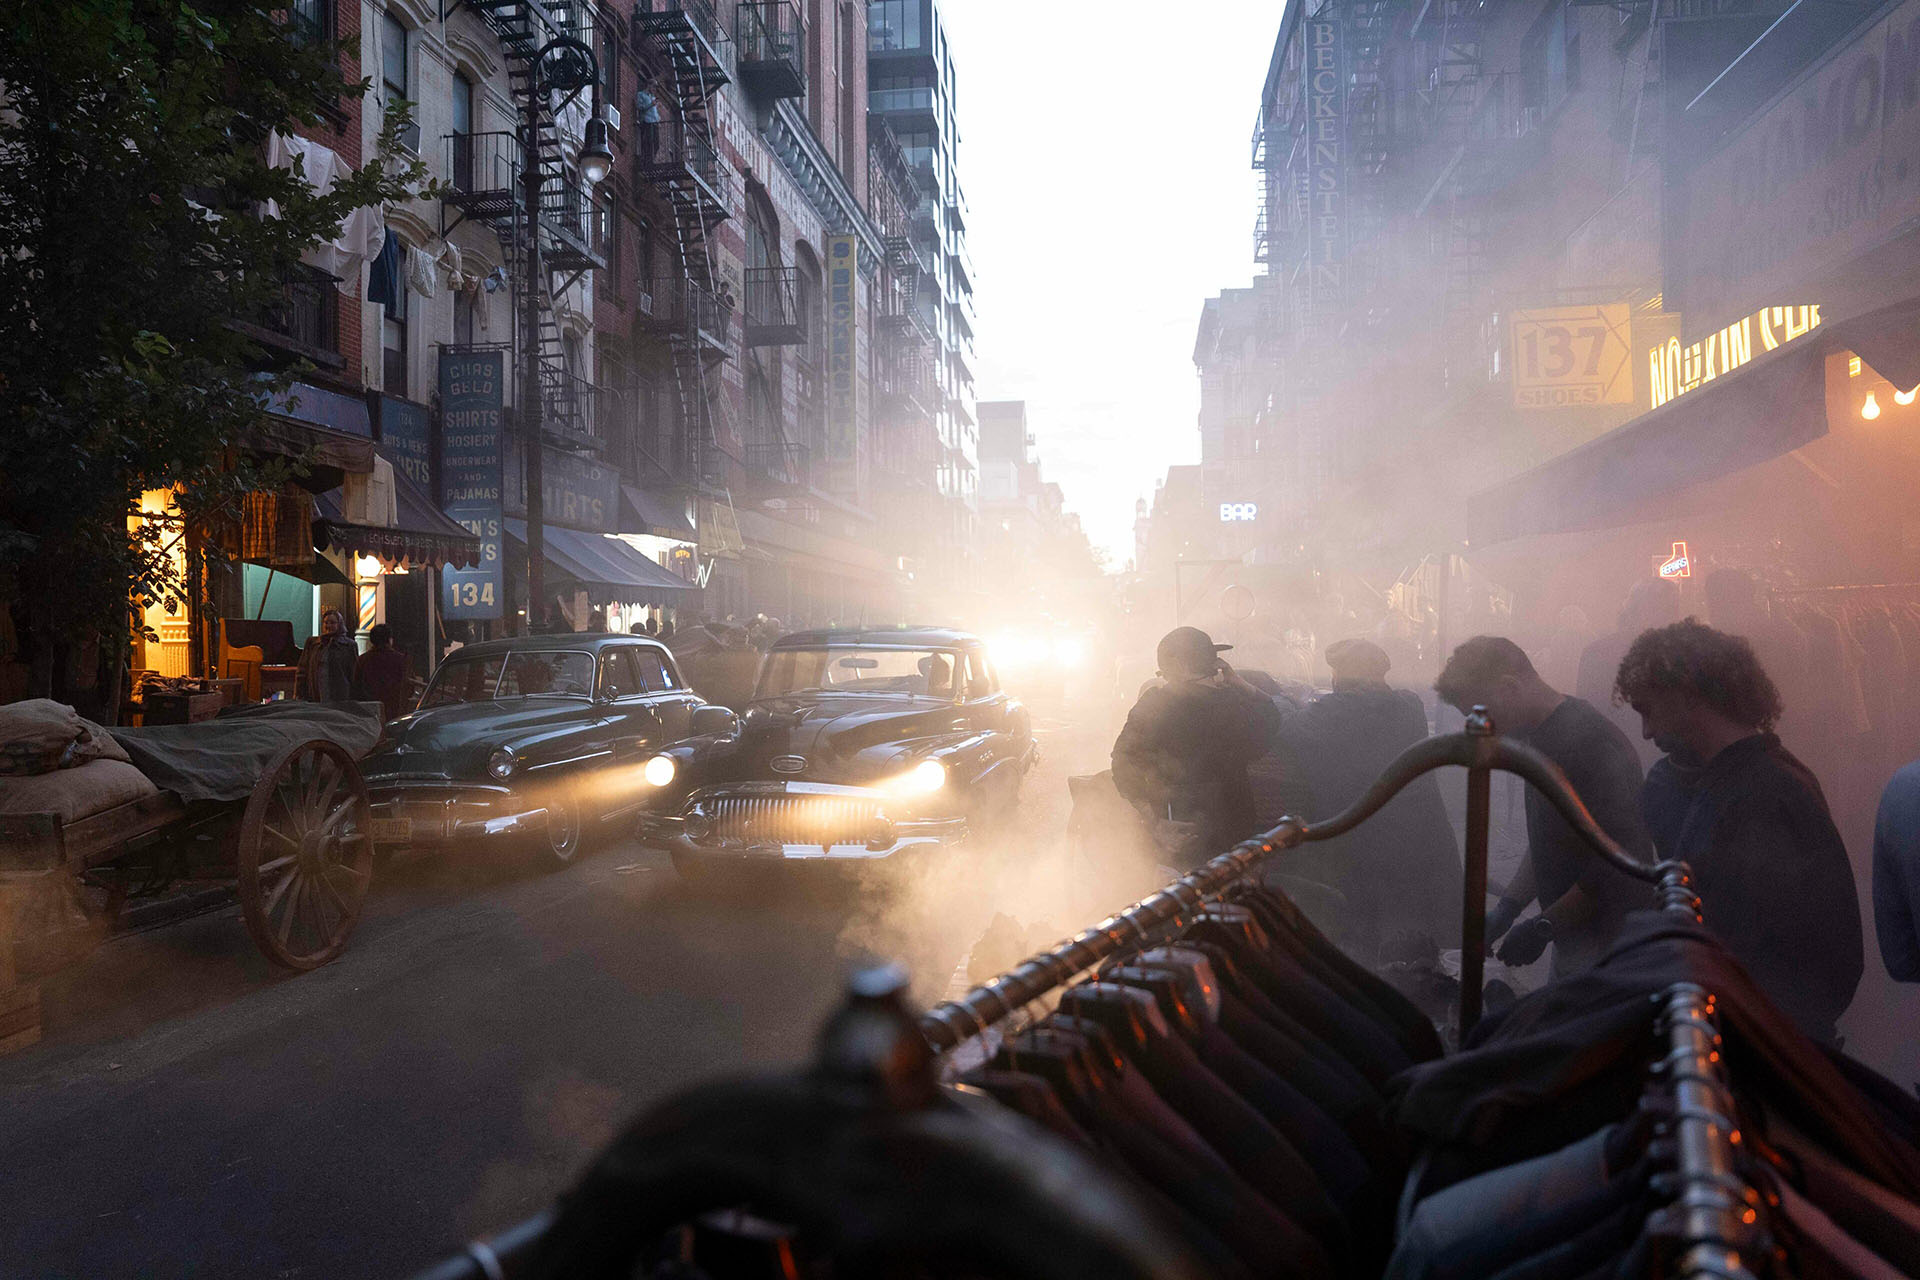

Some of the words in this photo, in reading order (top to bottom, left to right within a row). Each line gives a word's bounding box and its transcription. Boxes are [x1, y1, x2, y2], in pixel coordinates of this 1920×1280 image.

[1313, 24, 1342, 287] BECKENSTEIN
[1521, 326, 1607, 377] 137
[450, 380, 493, 396] GELD
[1519, 387, 1599, 405] SHOES
[446, 410, 499, 429] SHIRTS
[447, 432, 497, 448] HOSIERY
[446, 455, 497, 466] UNDERWEAR
[446, 488, 499, 500] PAJAMAS
[1220, 503, 1257, 521] BAR
[1661, 557, 1687, 576] REPAIRS
[451, 582, 495, 607] 134
